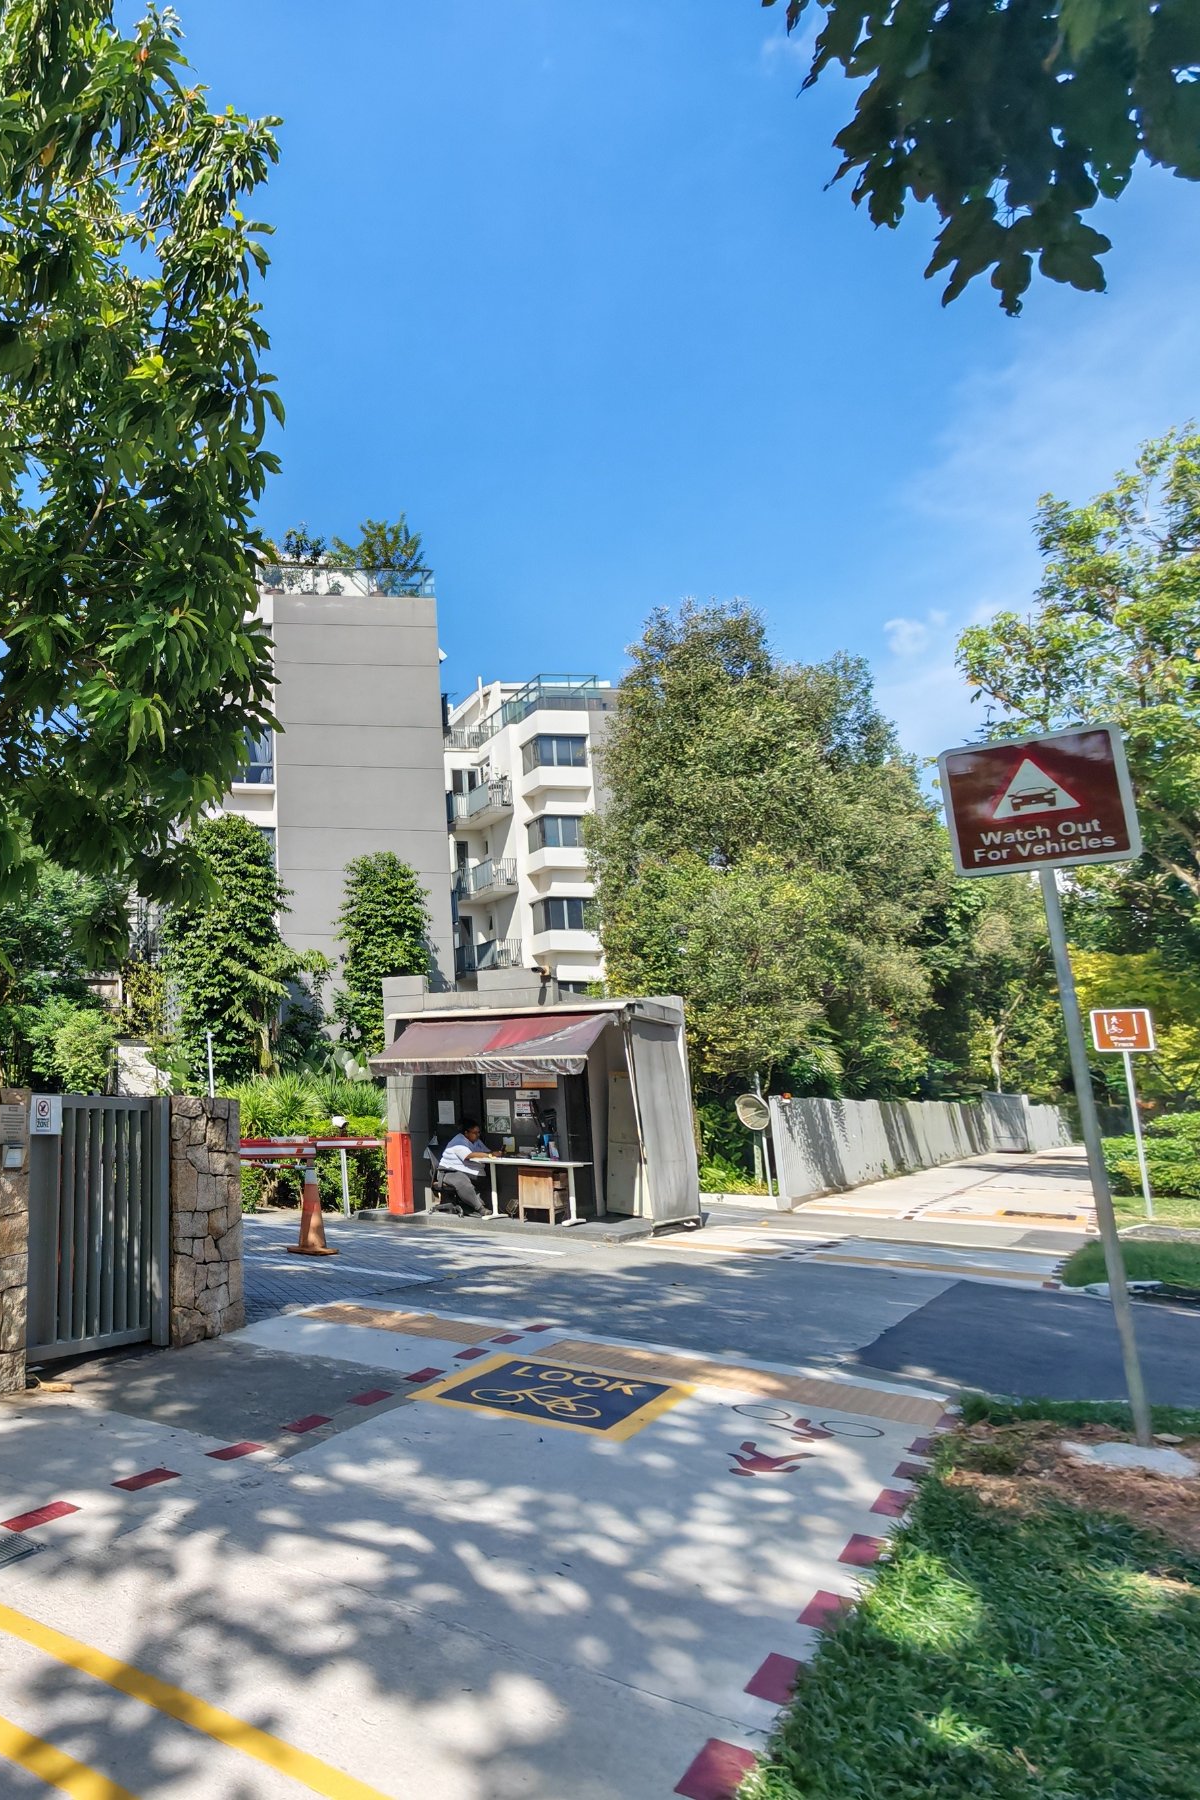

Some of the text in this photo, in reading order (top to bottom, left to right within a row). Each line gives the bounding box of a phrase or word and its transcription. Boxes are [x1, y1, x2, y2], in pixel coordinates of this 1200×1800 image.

[979, 818, 1102, 846] Watch Out
[973, 835, 1118, 863] For Vehicles
[511, 1365, 647, 1396] LOOK
